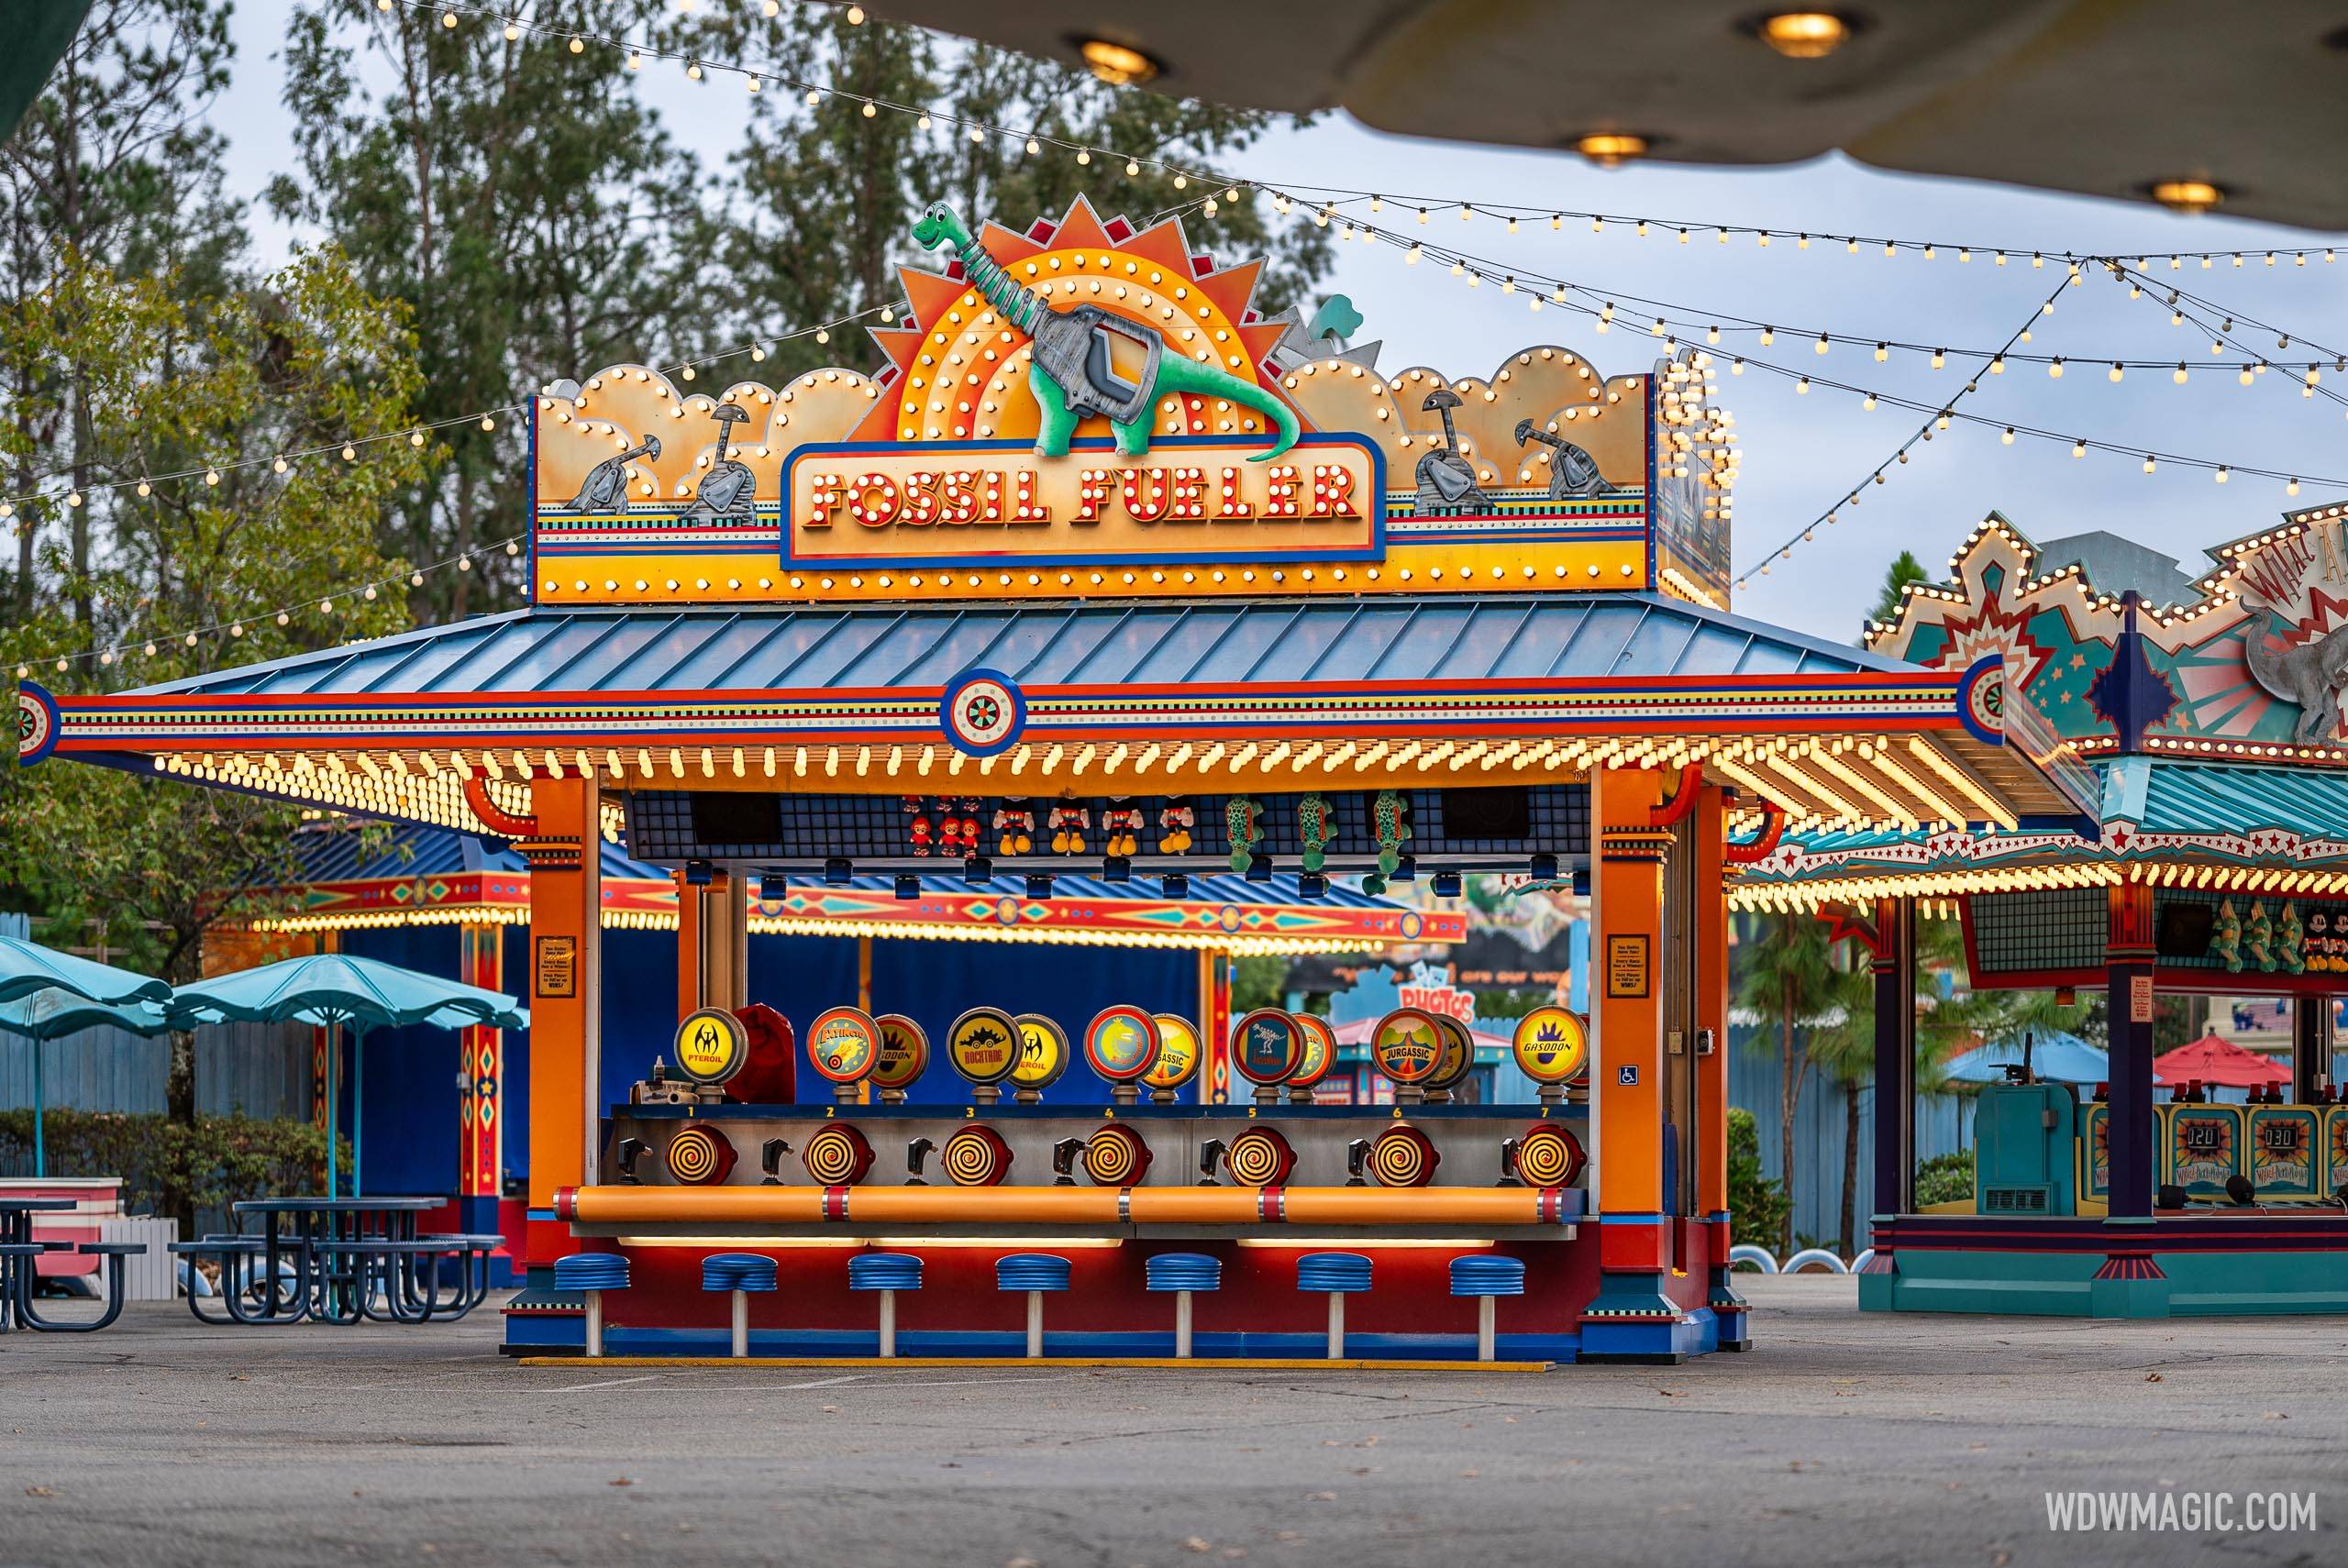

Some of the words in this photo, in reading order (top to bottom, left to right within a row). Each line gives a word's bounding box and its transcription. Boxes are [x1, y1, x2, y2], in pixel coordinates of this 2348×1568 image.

[802, 467, 1051, 529] FOSSIL
[1069, 465, 1363, 525] FUELER
[1524, 1042, 1572, 1052] GASODON
[1386, 1047, 1430, 1059] JURGASSIC
[688, 1055, 723, 1063] PTEROIL
[1020, 1061, 1046, 1070] EROIL
[688, 1106, 694, 1117] 1
[826, 1107, 835, 1118] 2
[966, 1107, 974, 1118] 3
[1104, 1108, 1113, 1119] 4
[1248, 1108, 1257, 1118] 5
[1392, 1107, 1402, 1118] 6
[1541, 1107, 1549, 1118] 7
